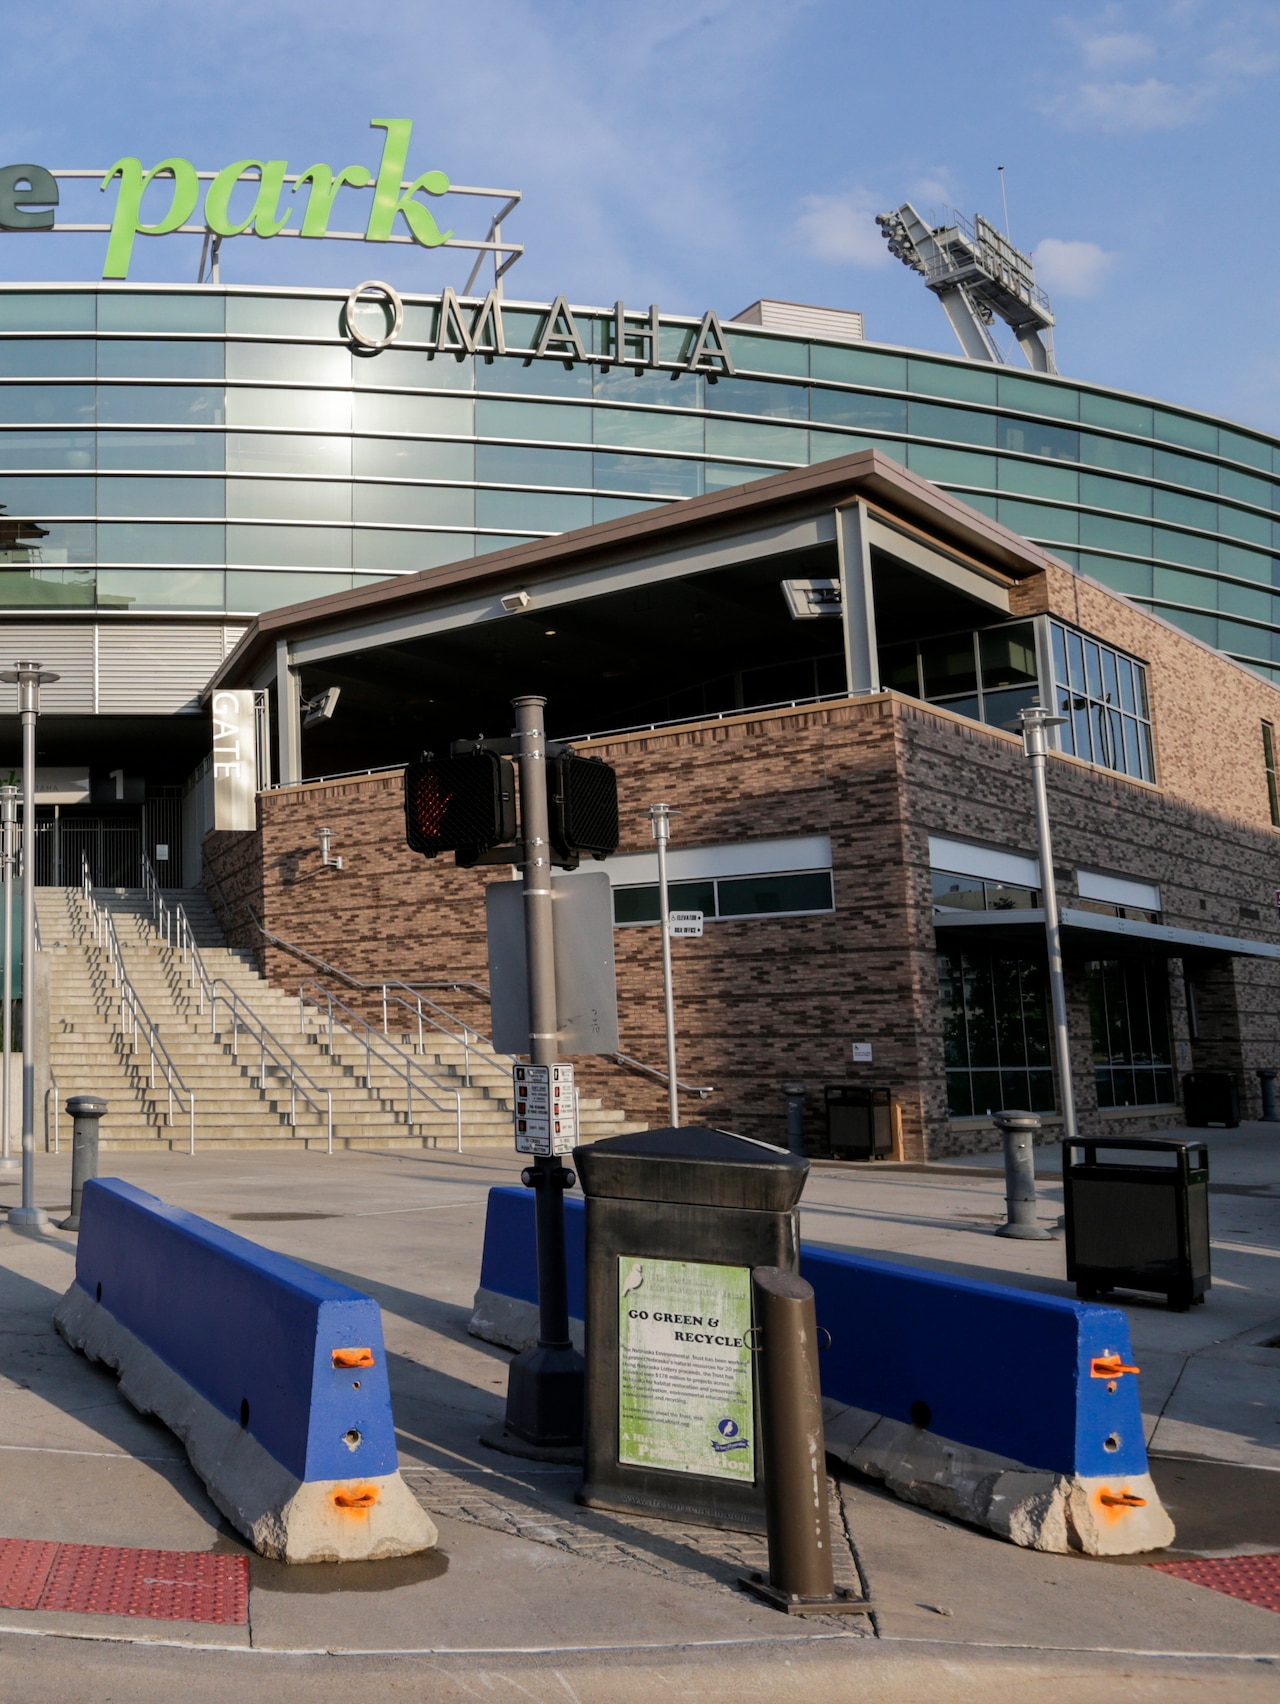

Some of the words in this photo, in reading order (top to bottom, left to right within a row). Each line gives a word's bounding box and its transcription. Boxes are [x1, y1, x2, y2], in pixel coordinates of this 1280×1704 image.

[99, 118, 454, 280] park
[346, 280, 735, 375] OMAHA
[212, 692, 241, 778] GATE
[109, 769, 124, 799] 1
[628, 1309, 649, 1320] GO
[654, 1312, 703, 1327] GREEN
[708, 1317, 720, 1328] &
[674, 1331, 743, 1348] RECYCLE
